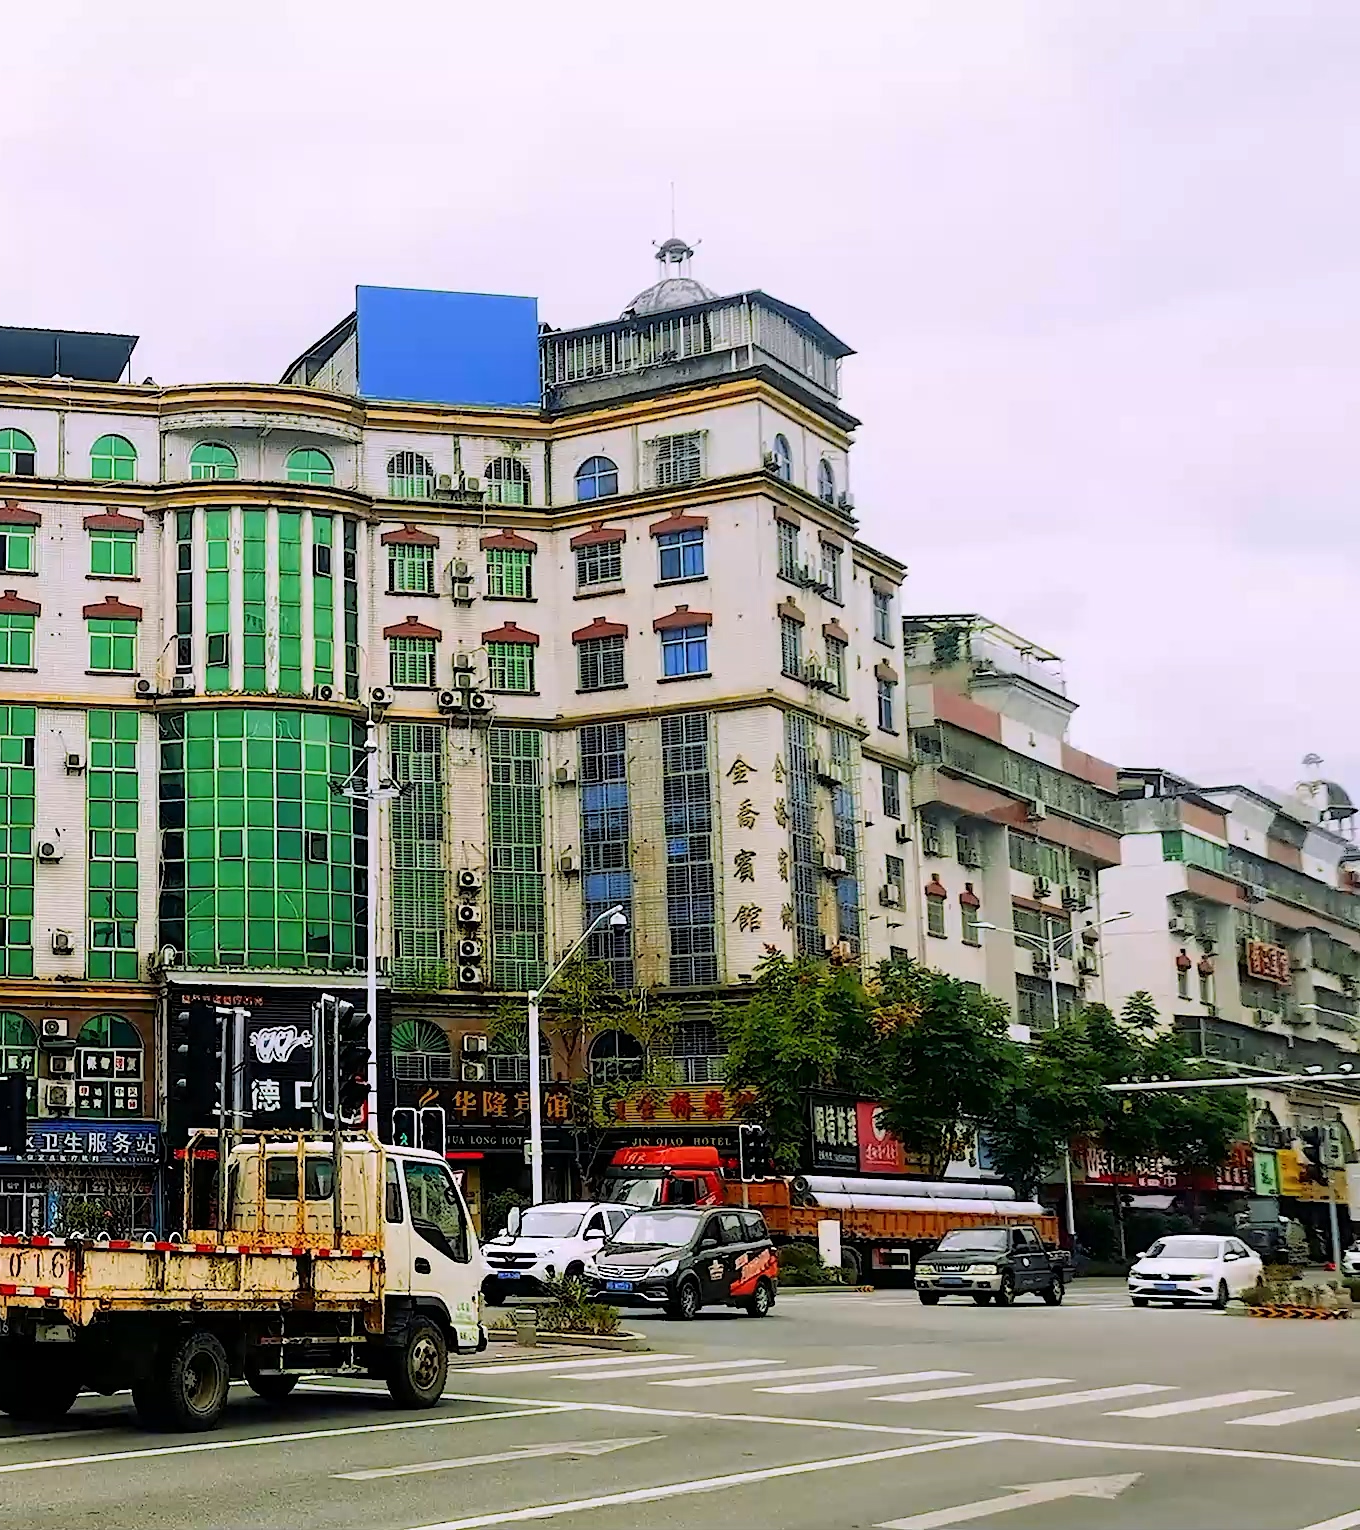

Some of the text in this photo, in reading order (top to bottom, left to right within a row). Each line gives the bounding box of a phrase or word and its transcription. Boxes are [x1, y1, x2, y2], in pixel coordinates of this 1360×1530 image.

[452, 1090, 571, 1119] 华隆宾馆
[470, 1136, 497, 1145] LONG
[632, 1138, 731, 1146] JIN QIAO HOTEL
